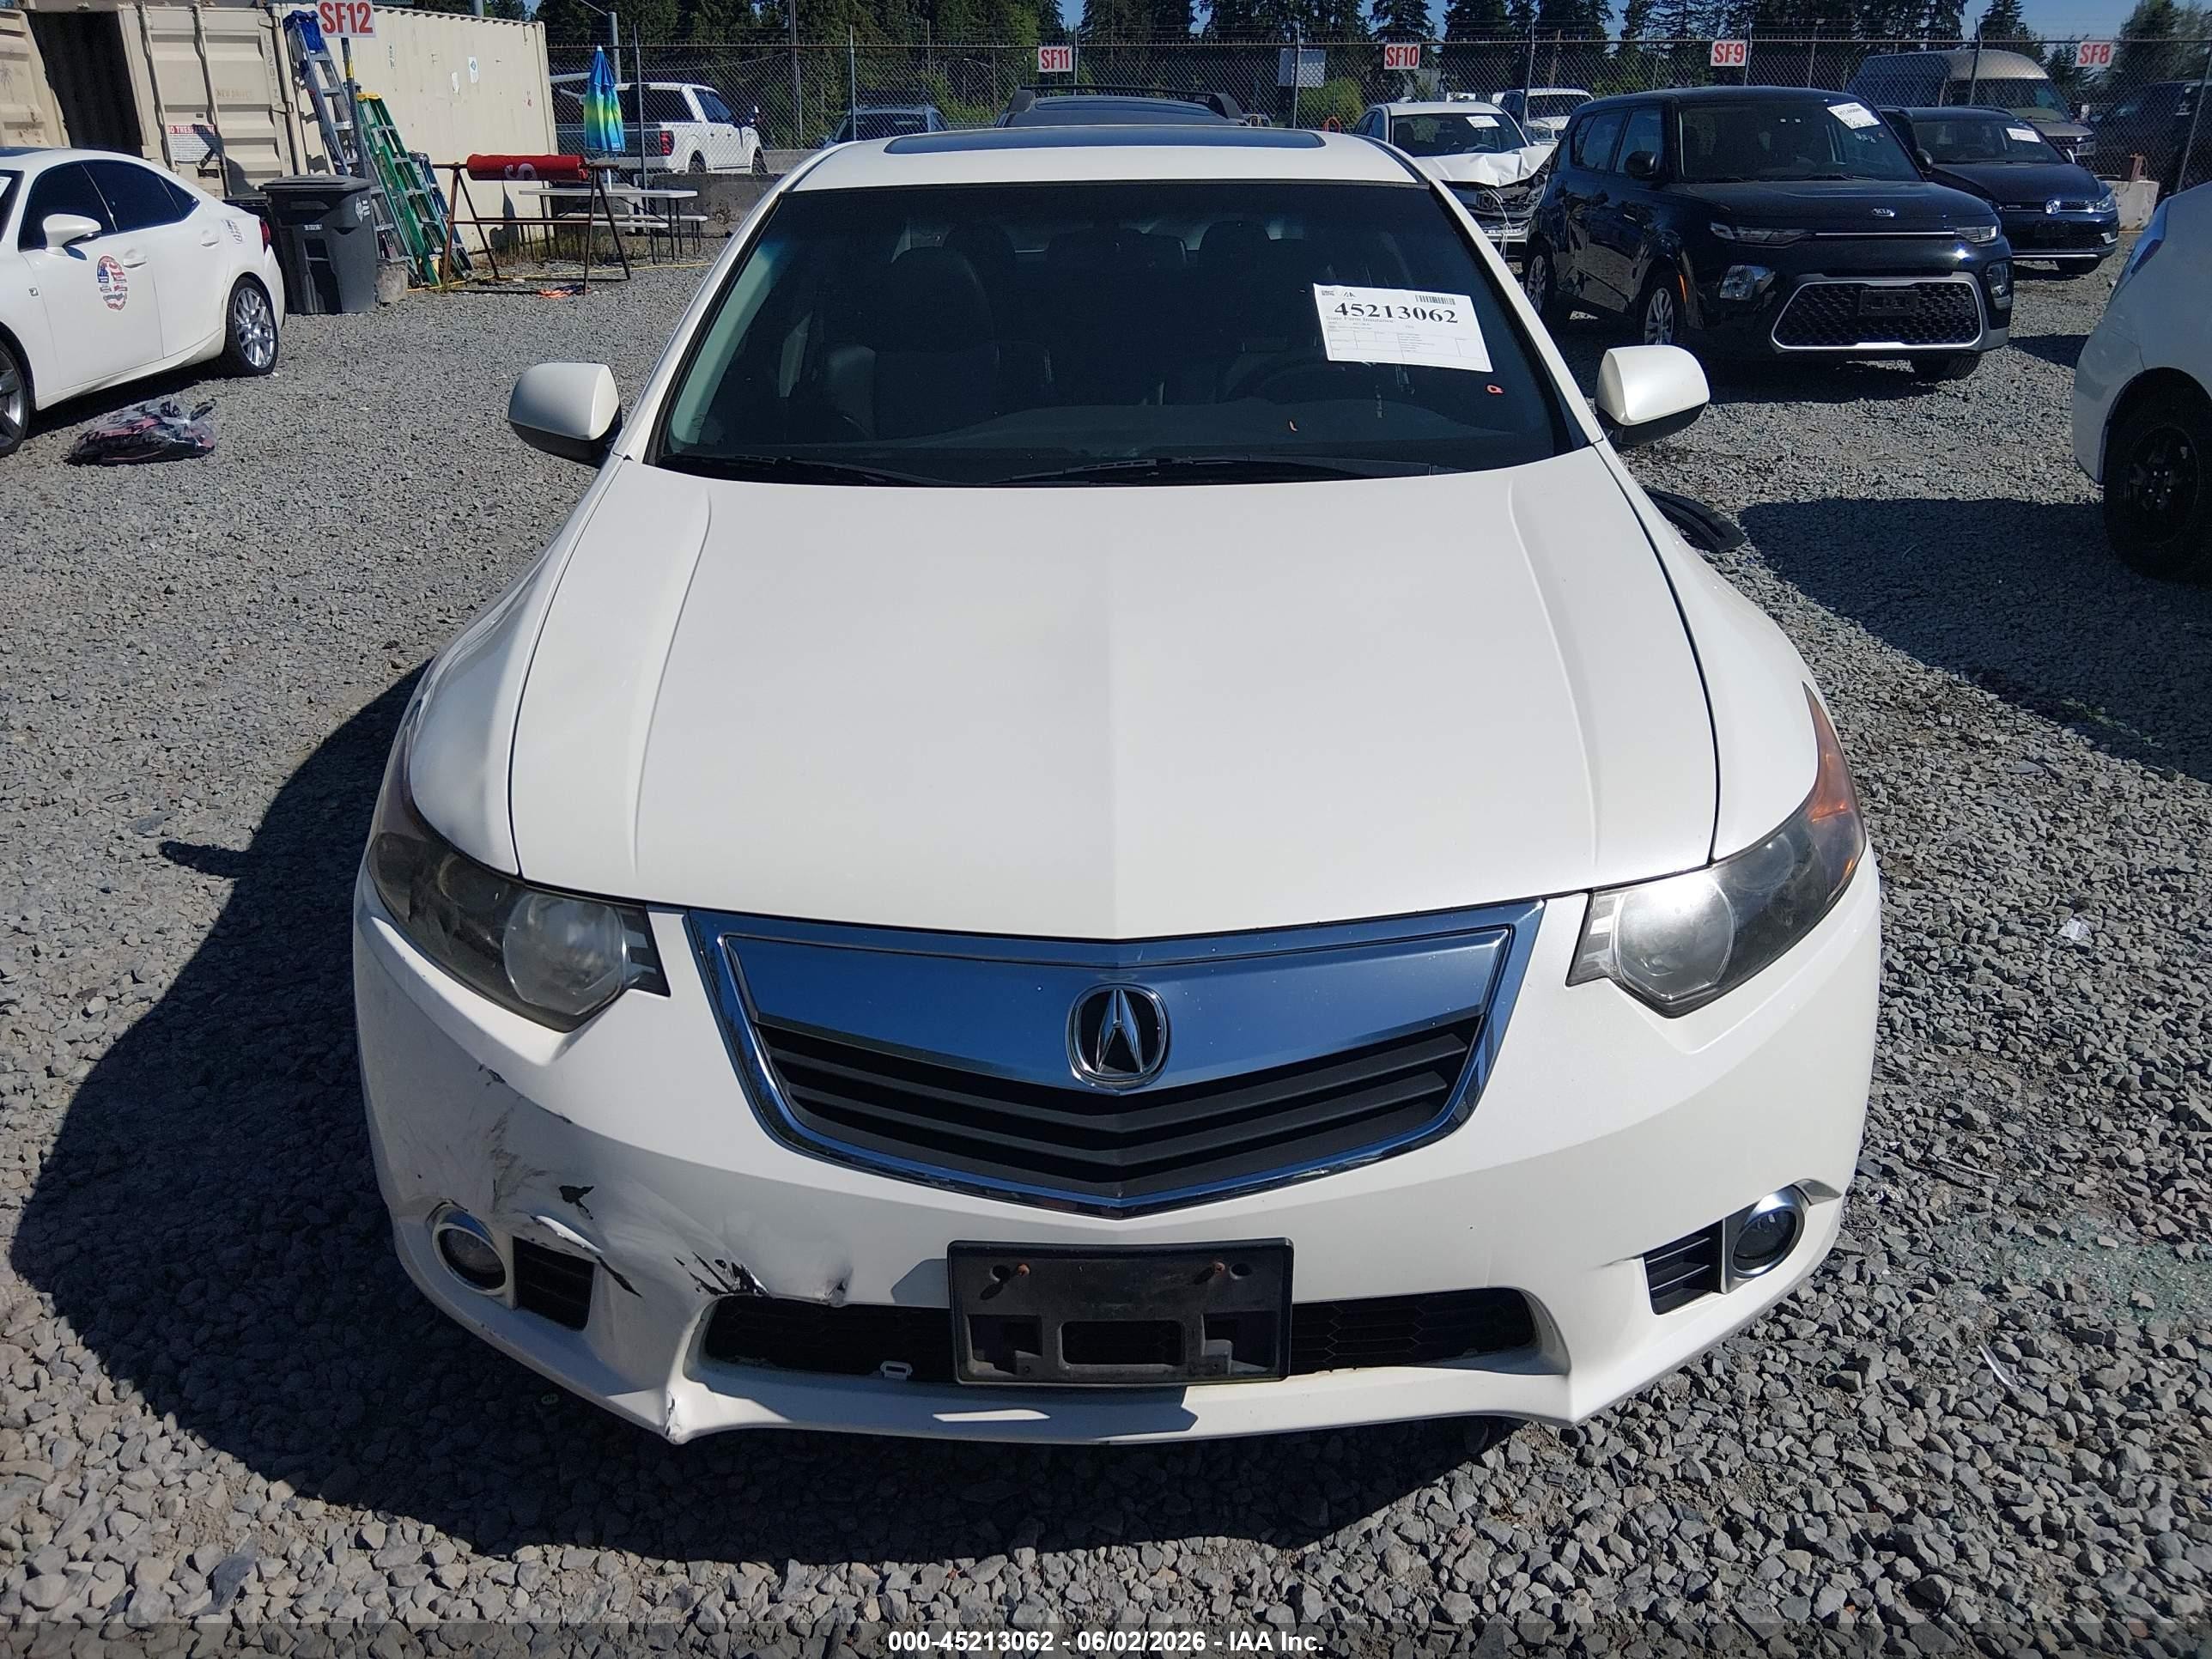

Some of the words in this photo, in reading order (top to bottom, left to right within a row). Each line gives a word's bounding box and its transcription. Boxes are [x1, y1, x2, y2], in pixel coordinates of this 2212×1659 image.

[320, 3, 373, 33] SF12
[1041, 49, 1069, 69] SF11
[1386, 46, 1419, 66] SF10
[1714, 43, 1744, 63] SF9
[2080, 44, 2110, 64] SF8
[1334, 302, 1458, 323] 45213062
